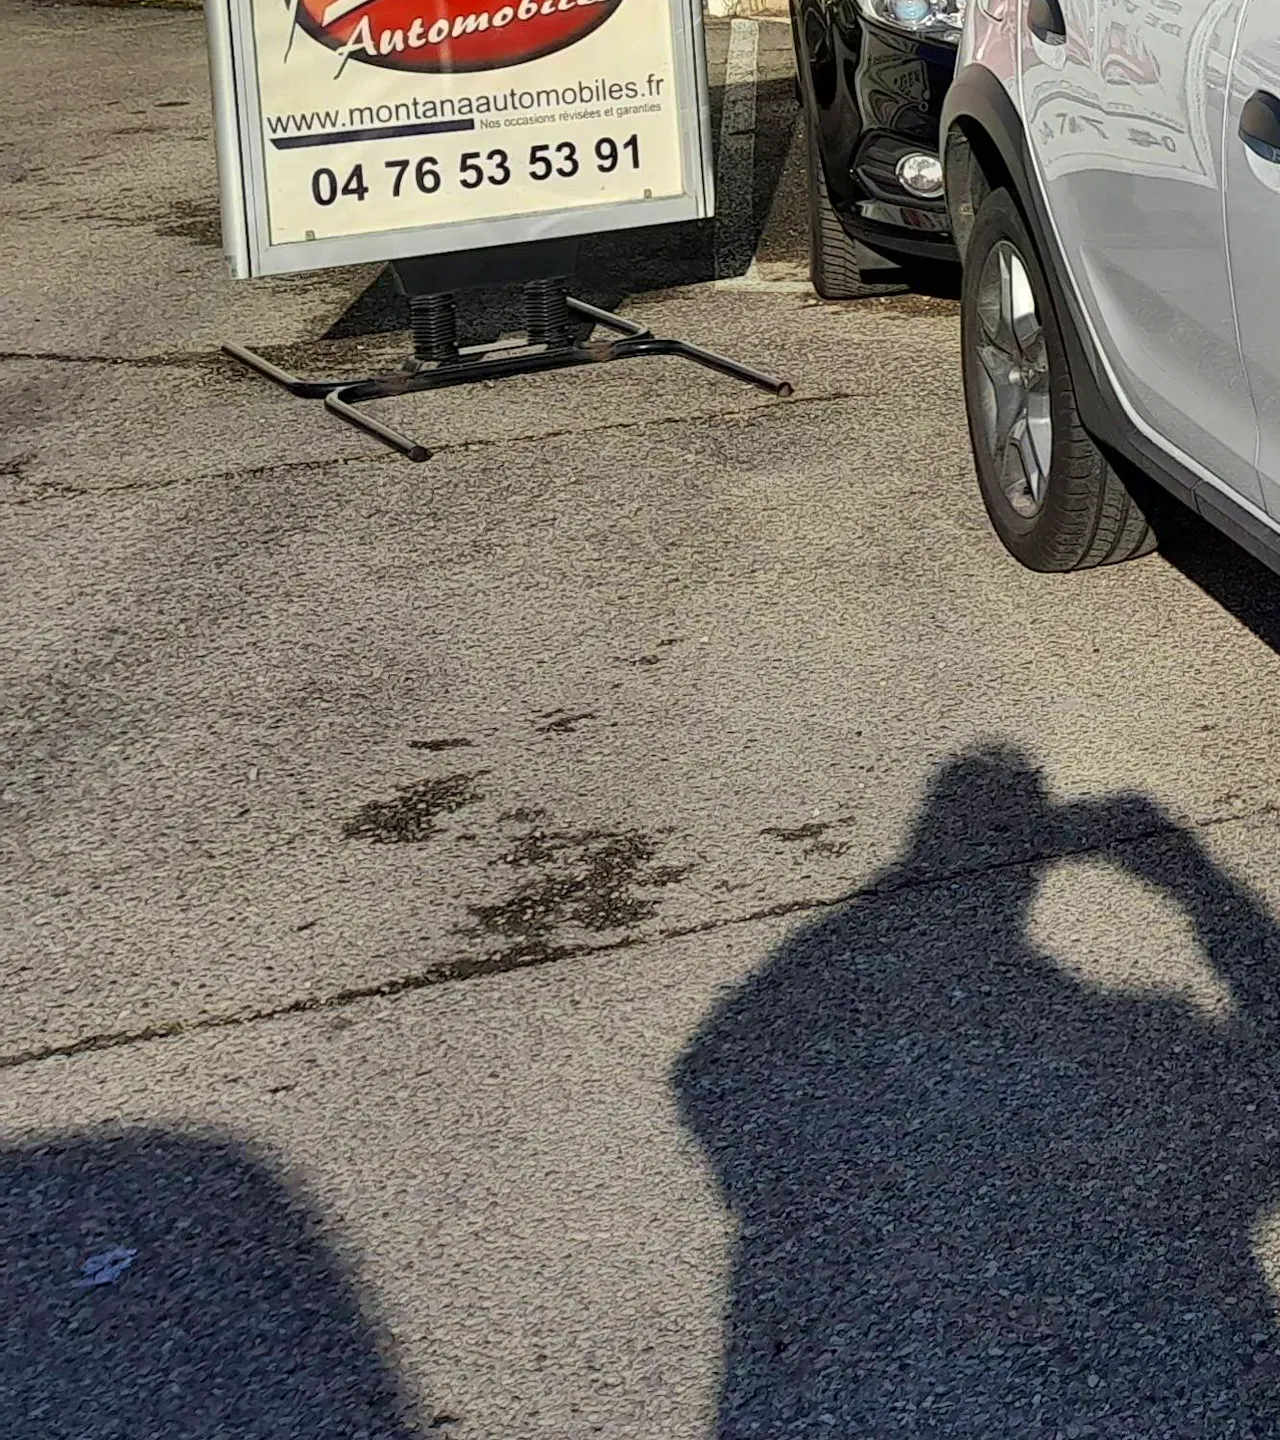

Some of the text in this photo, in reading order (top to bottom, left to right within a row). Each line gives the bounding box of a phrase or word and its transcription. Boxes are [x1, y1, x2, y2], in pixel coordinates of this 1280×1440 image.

[267, 73, 665, 135] www.montanaautomobiles.fr
[480, 118, 501, 130] Nos
[504, 113, 556, 128] occasions
[604, 106, 614, 117] et
[616, 102, 662, 118] garanties
[312, 133, 643, 206] 04 76 53 53 91
